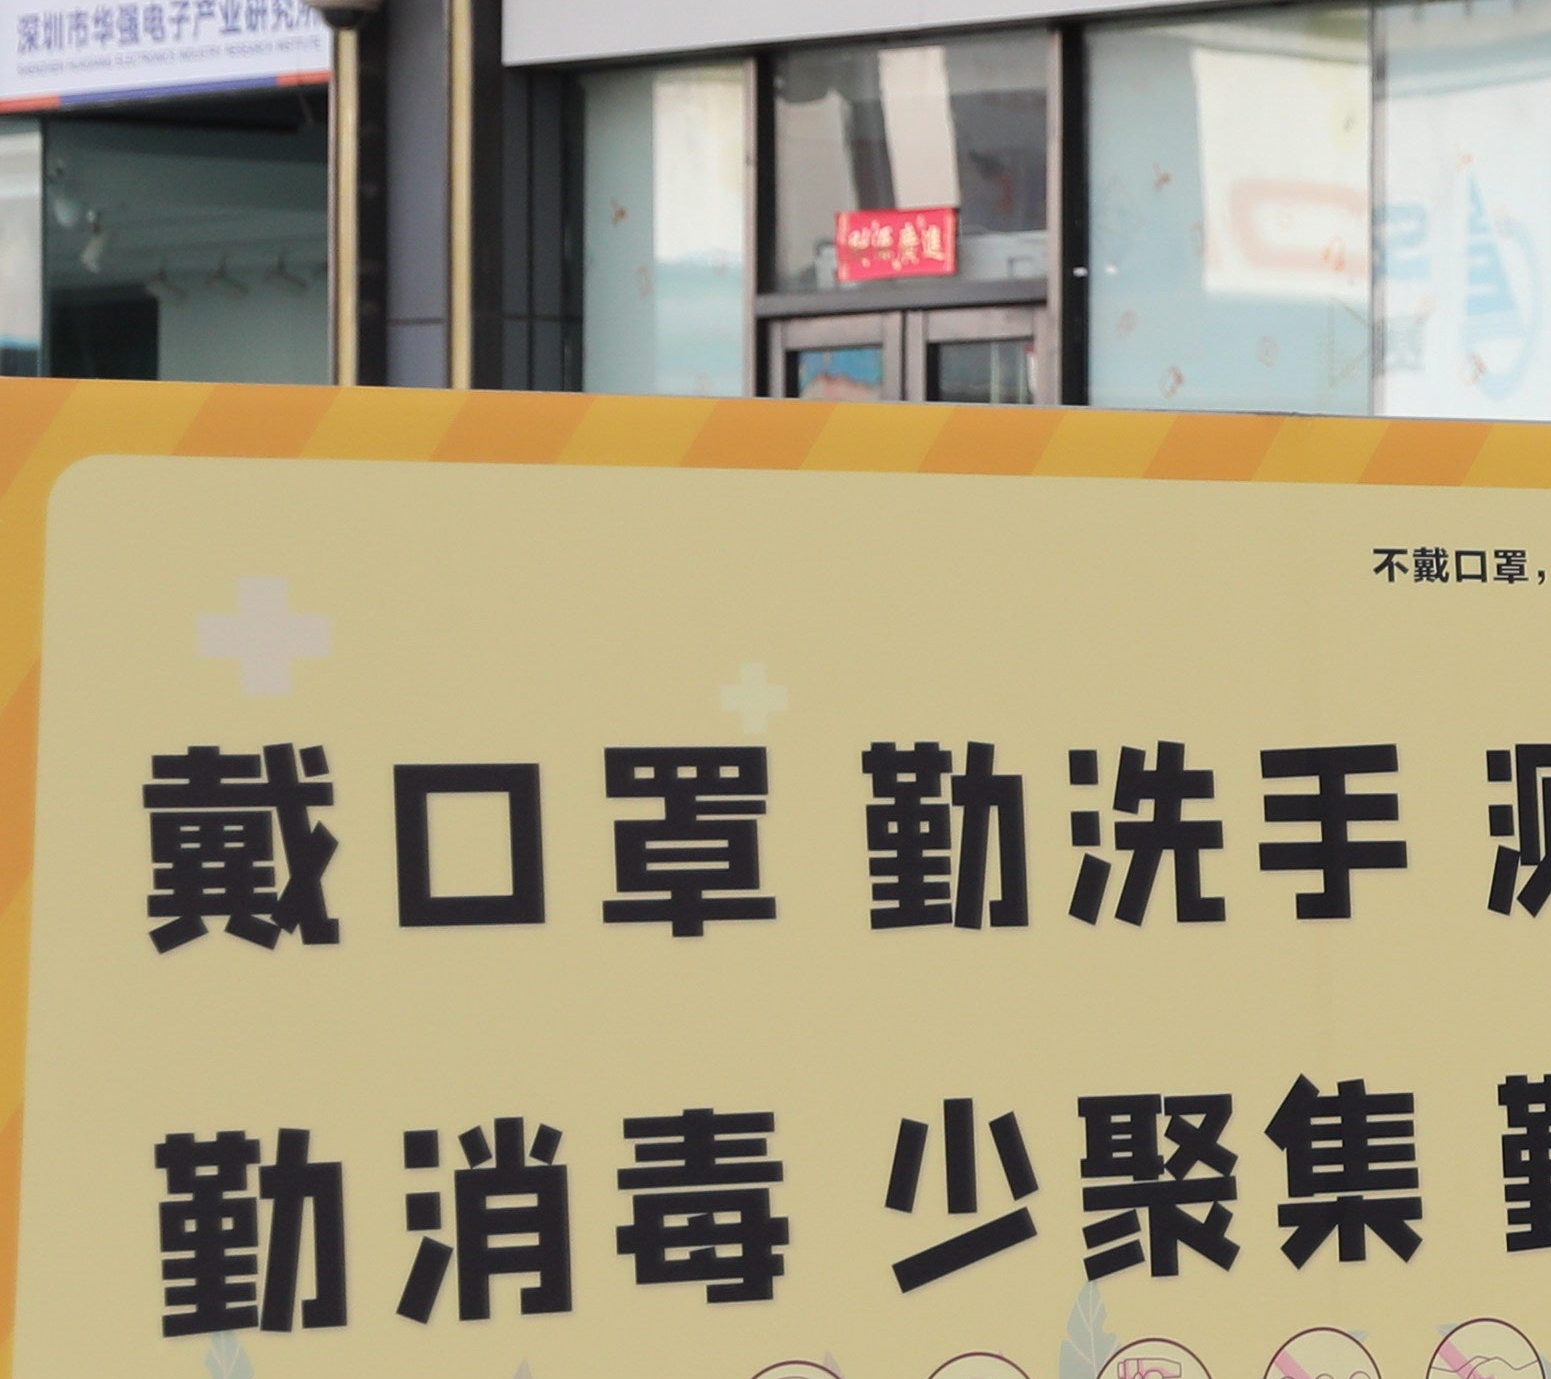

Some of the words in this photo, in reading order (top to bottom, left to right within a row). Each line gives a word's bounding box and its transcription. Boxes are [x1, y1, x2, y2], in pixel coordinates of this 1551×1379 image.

[141, 740, 778, 958] 戴口罩
[861, 738, 1410, 932] 勤洗手
[153, 1106, 791, 1341] 勤消毒
[883, 1073, 1426, 1297] 少聚集
